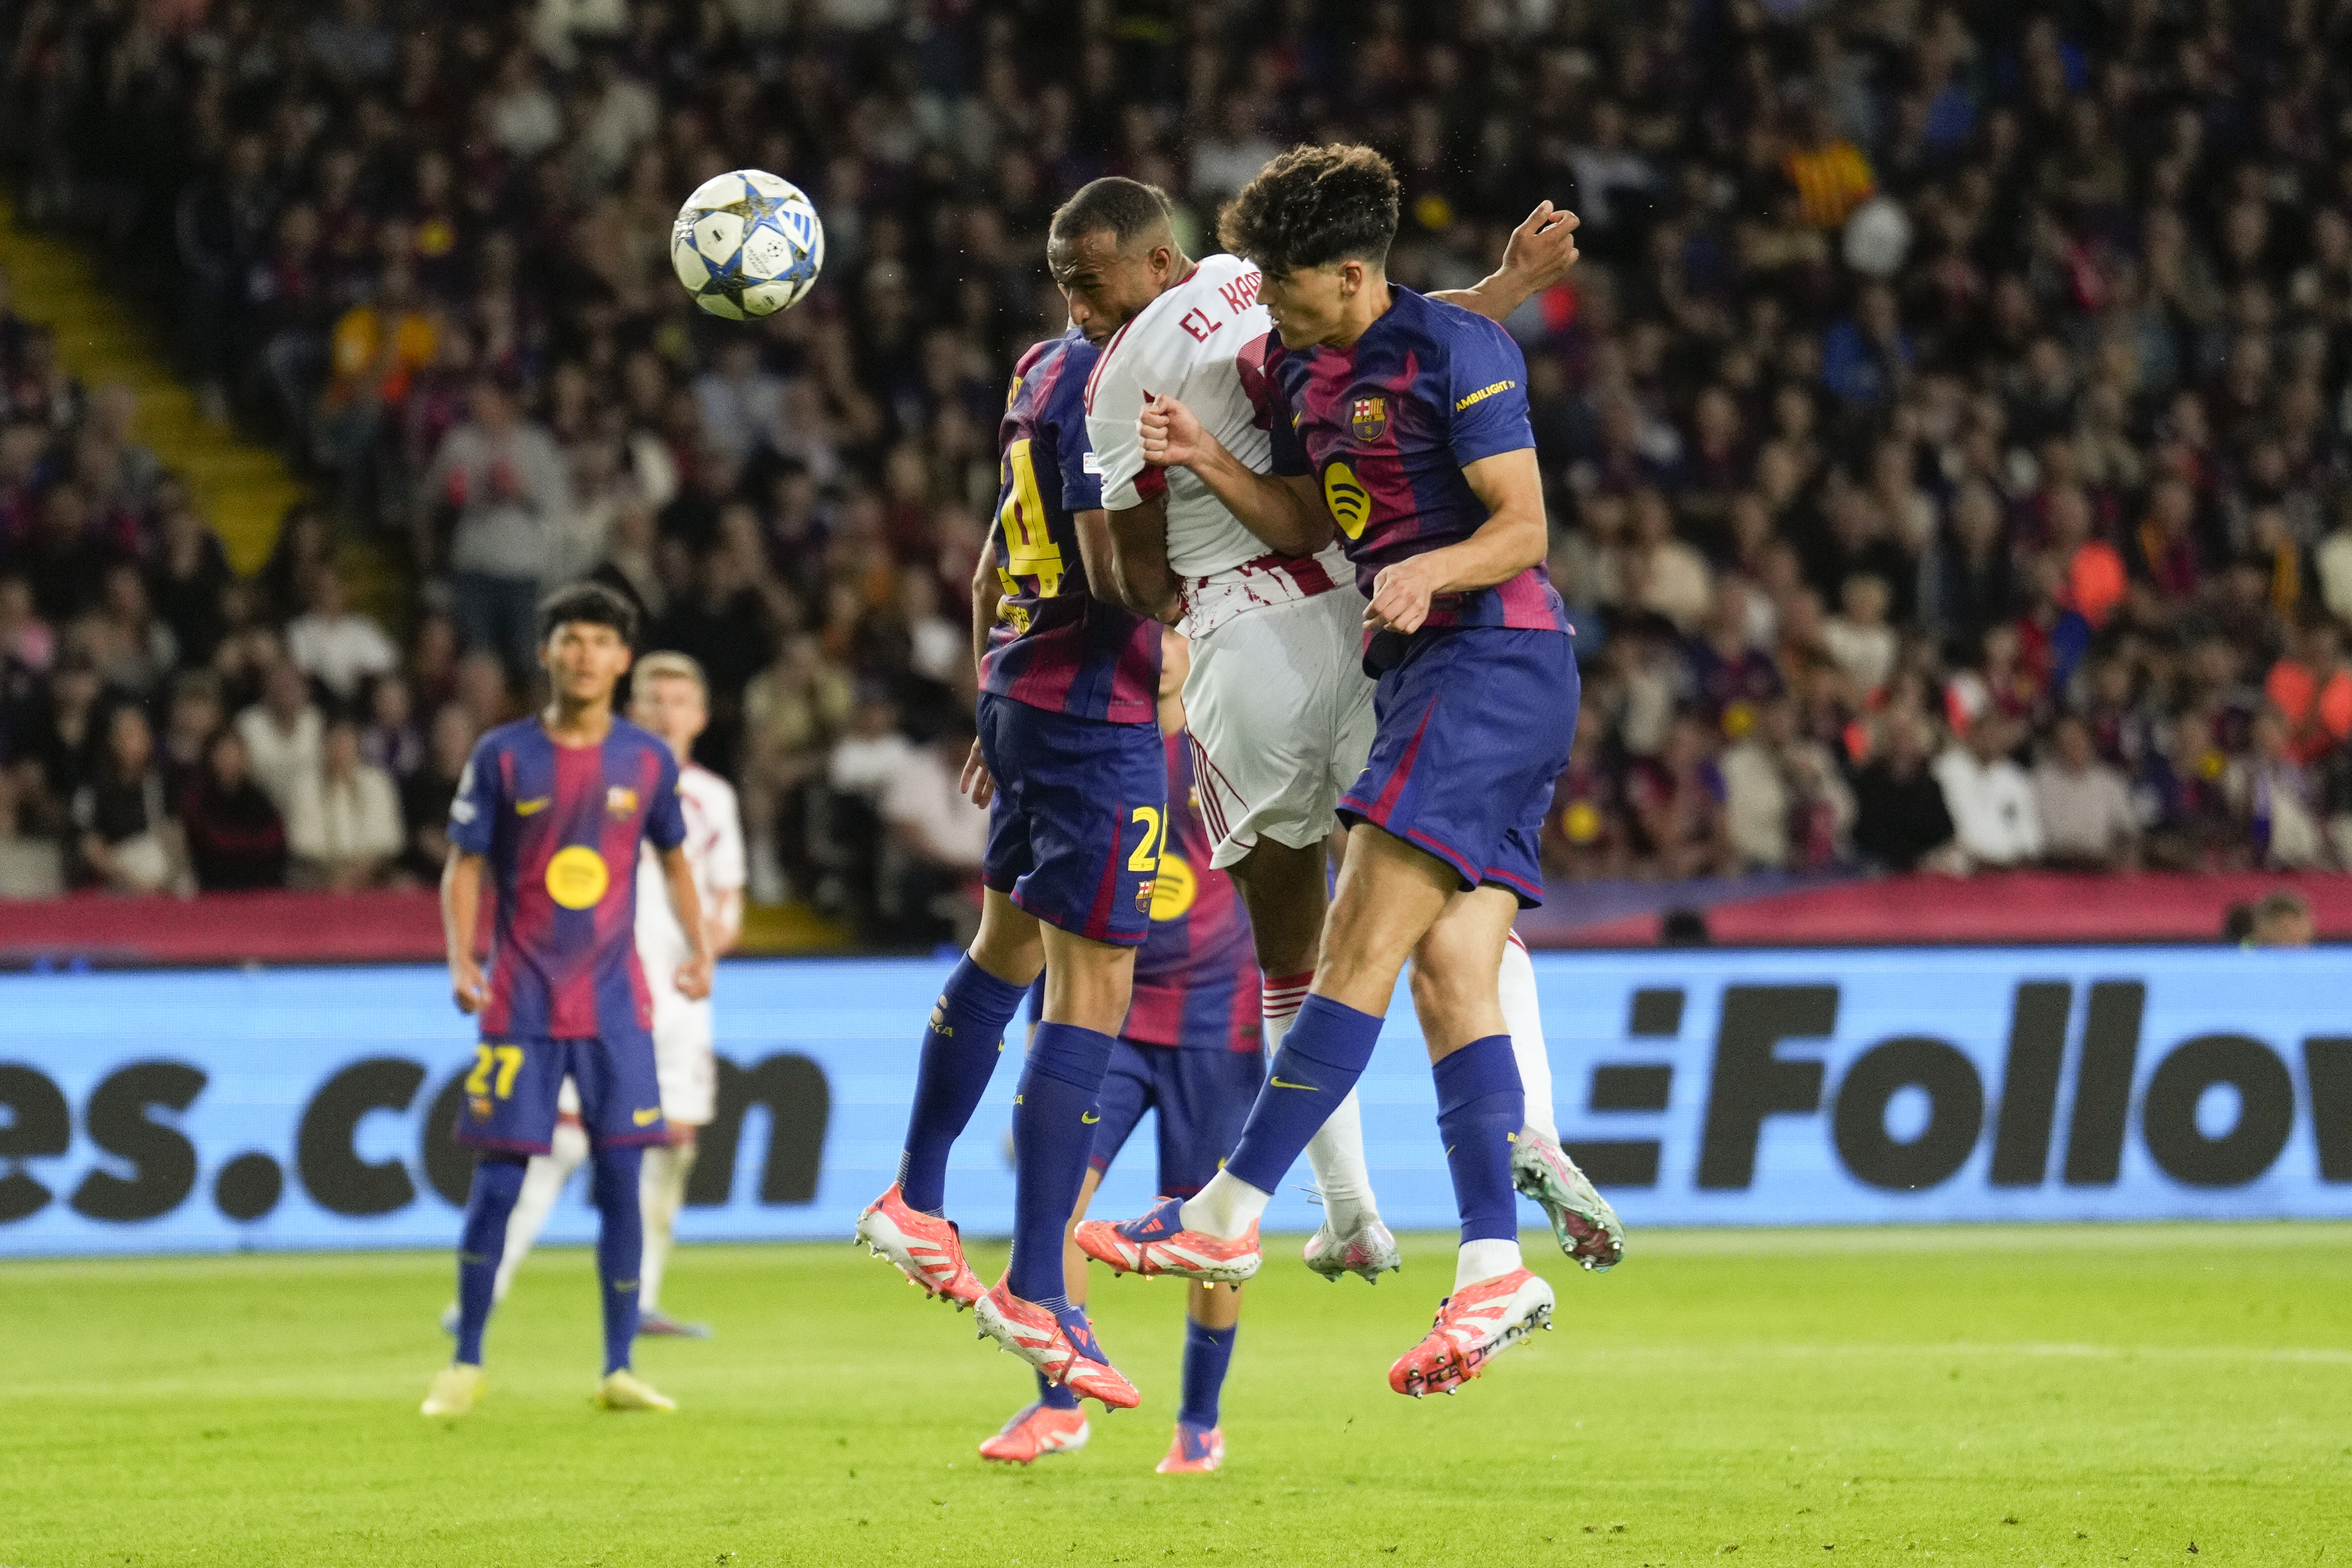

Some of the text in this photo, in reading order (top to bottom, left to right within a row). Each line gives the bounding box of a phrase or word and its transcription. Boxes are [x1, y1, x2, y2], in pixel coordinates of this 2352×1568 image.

[1178, 307, 1223, 344] EL
[1455, 380, 1508, 412] AMBILIGHT
[998, 438, 1064, 598] 4
[1128, 802, 1168, 872] 2
[466, 1043, 525, 1099] 27
[1694, 979, 2352, 1191] Follo
